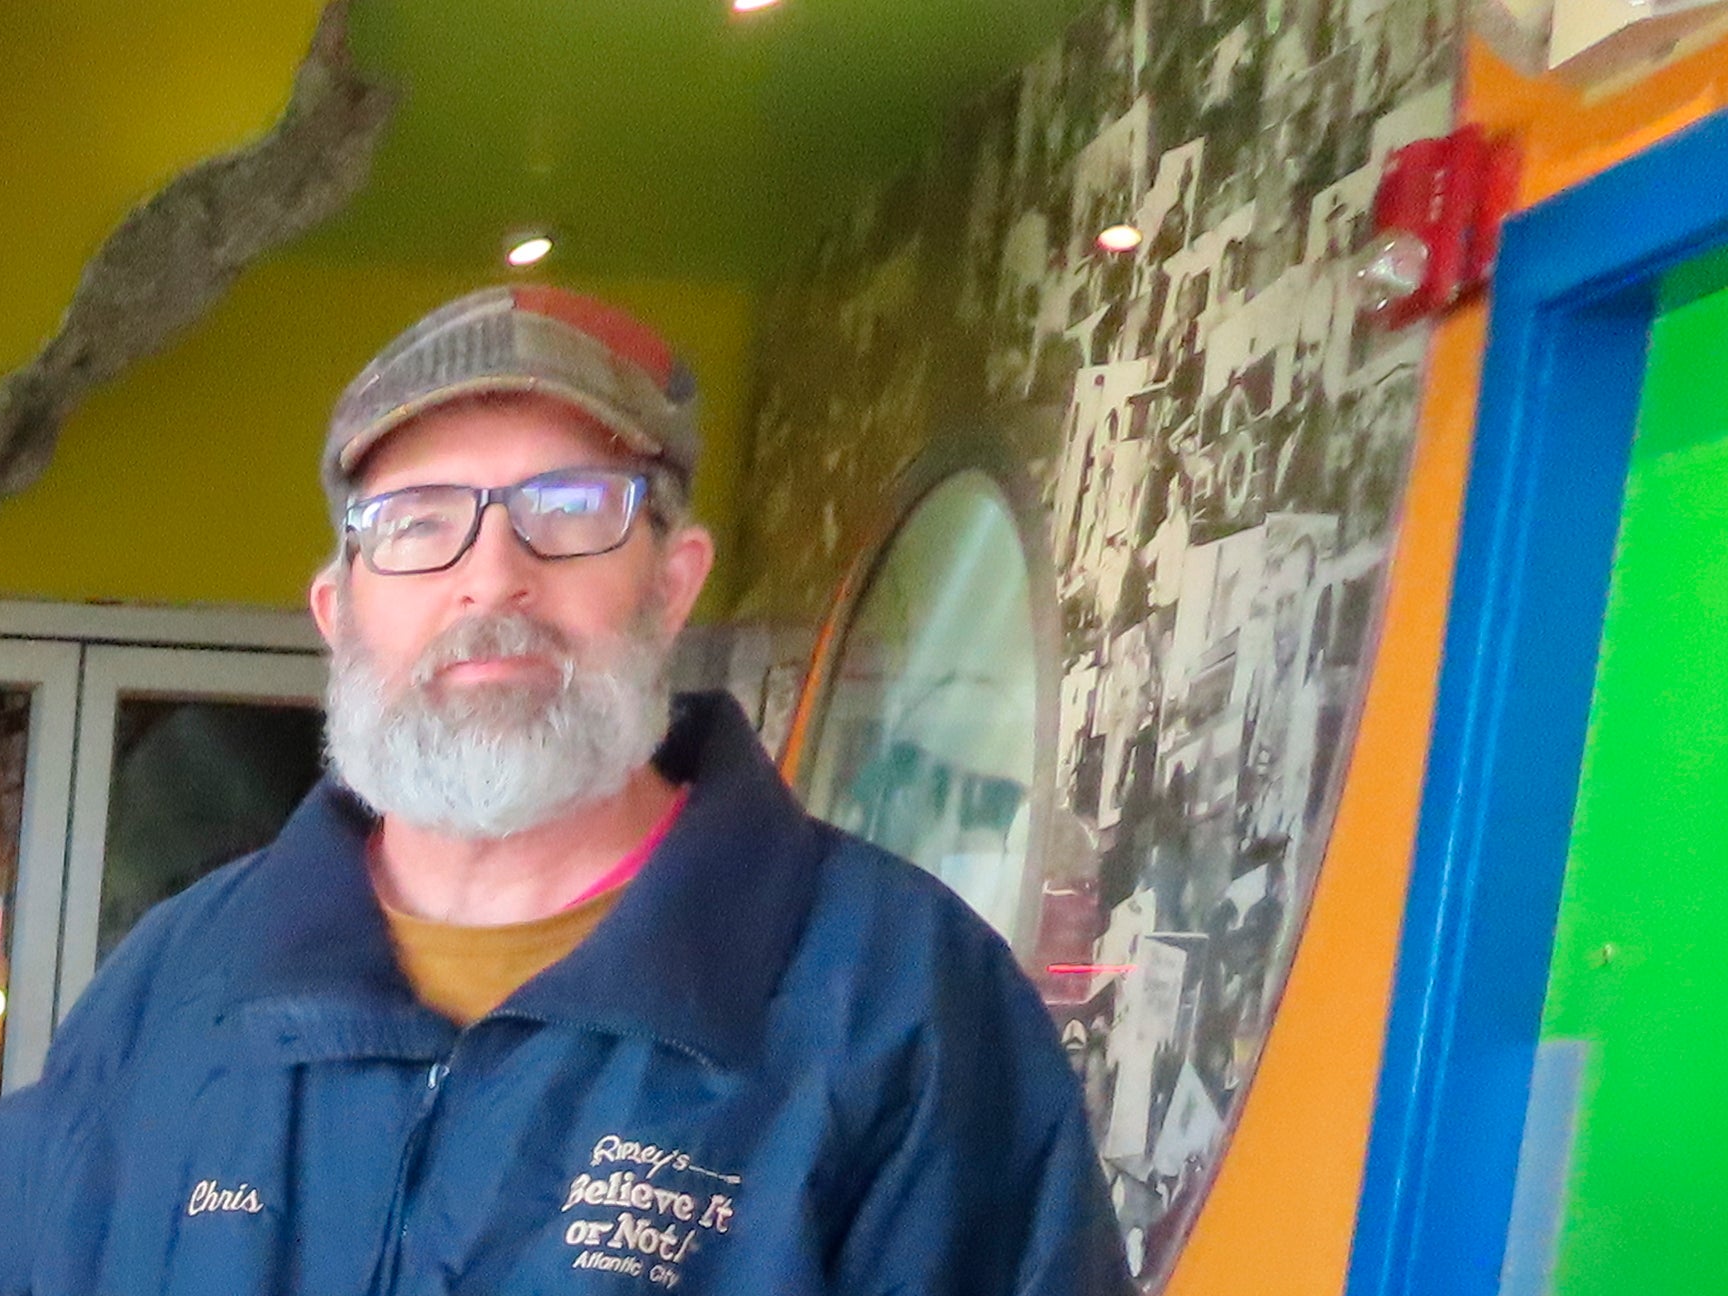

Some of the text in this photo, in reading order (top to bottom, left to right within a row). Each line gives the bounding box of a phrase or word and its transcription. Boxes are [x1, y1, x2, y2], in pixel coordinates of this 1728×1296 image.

[188, 1180, 263, 1217] Chris
[561, 1172, 735, 1233] Believe It
[565, 1219, 614, 1245] or
[572, 1250, 681, 1289] Atlantic City
